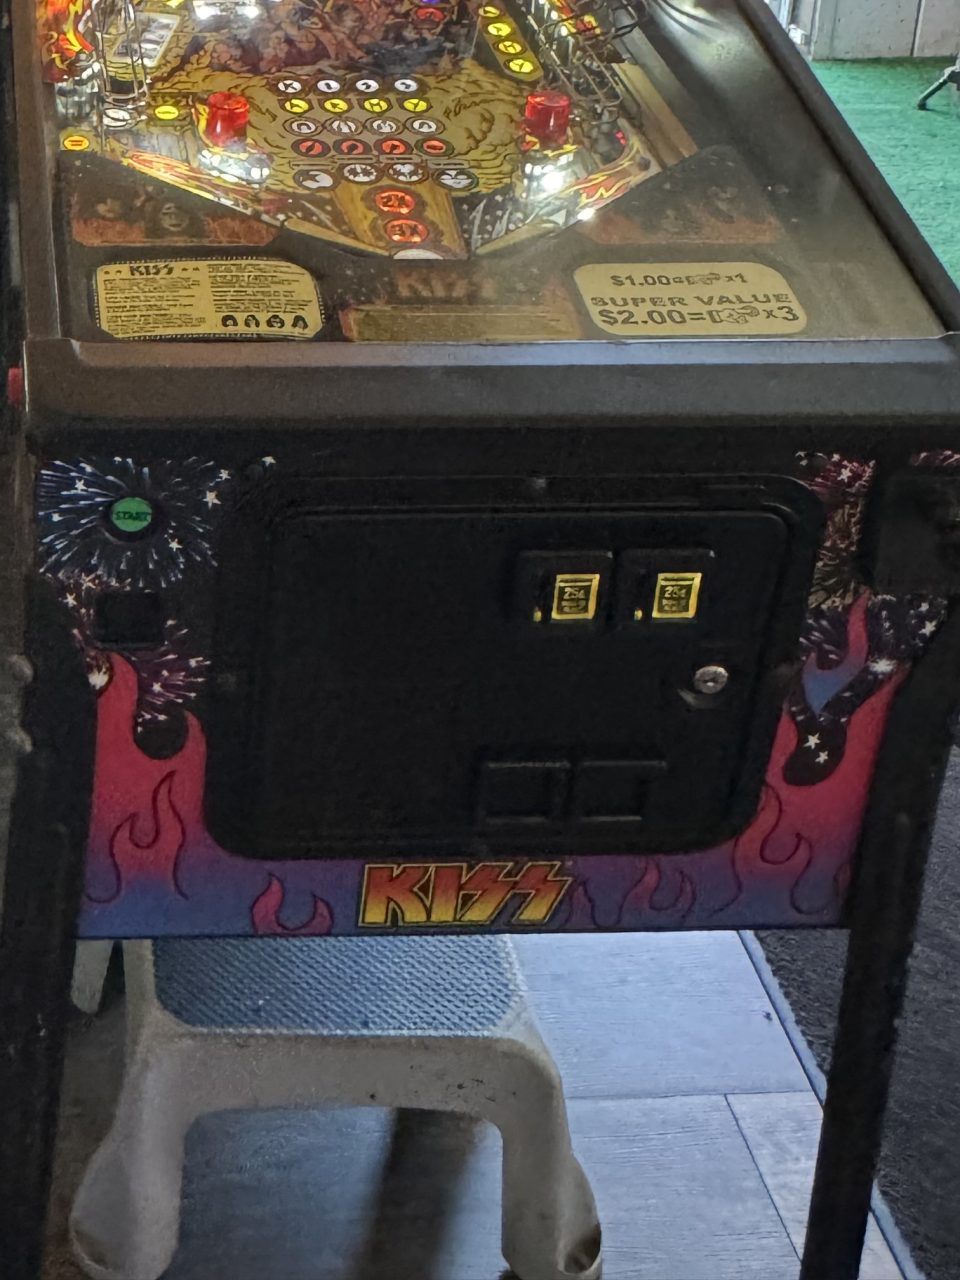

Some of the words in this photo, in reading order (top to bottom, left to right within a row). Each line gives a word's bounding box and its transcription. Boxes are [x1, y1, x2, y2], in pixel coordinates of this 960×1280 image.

[129, 264, 175, 277] KISS
[590, 296, 689, 307] SUPER
[693, 293, 792, 306] VALUE
[115, 511, 152, 521] START
[358, 861, 573, 927] KISS
